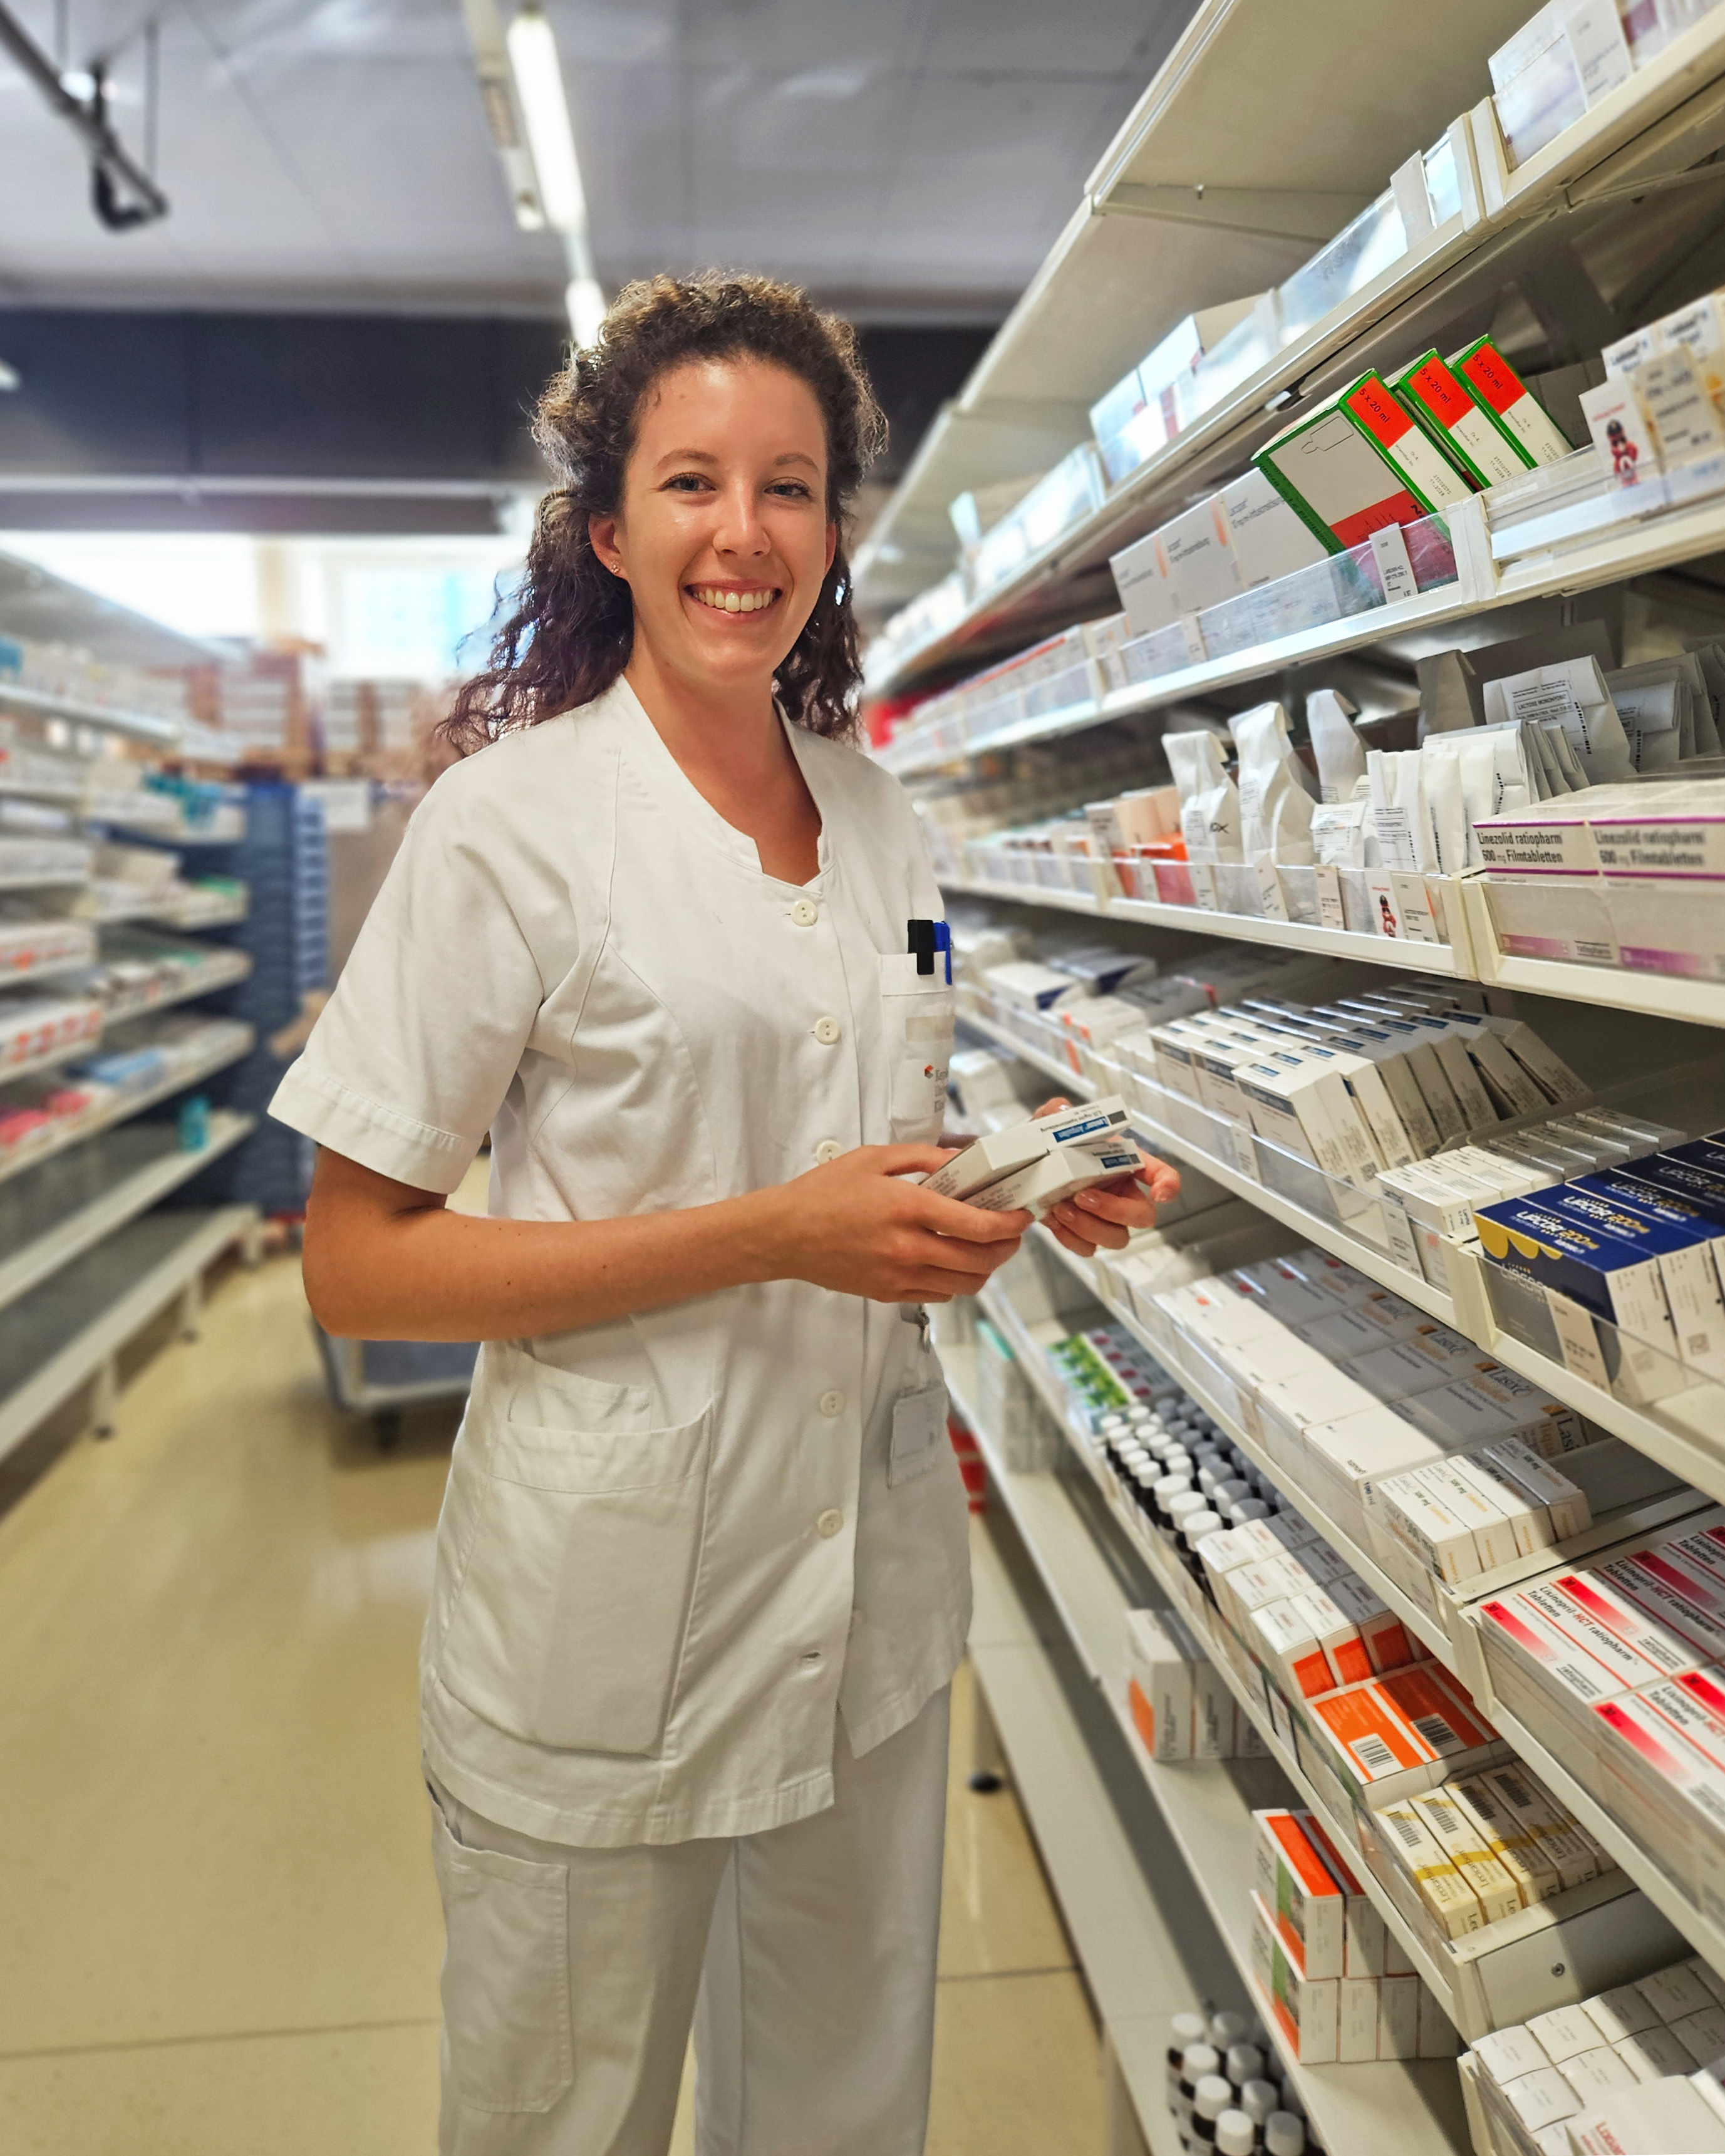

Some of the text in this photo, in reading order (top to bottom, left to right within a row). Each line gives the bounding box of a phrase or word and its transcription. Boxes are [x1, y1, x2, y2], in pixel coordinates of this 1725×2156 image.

[1483, 366, 1494, 379] 20
[1492, 379, 1503, 390] ml
[1431, 381, 1442, 394] 20
[1439, 392, 1451, 404] ml
[1370, 400, 1381, 413] 20
[1379, 412, 1391, 423] ml
[1478, 831, 1563, 847] Linezolid ratiopharm
[1594, 831, 1705, 849] Linezolid ratiopharm
[1482, 850, 1496, 861] 600
[1507, 850, 1563, 864] Filmtabletten
[1599, 851, 1616, 864] 600
[1630, 851, 1705, 866] Filmtabletten
[1678, 1539, 1716, 1565] Tabletten
[1603, 1564, 1639, 1592] Tabletten
[1528, 1590, 1561, 1618] Tabletten
[1539, 1586, 1594, 1627] Lisinopril-HCT
[1589, 1624, 1633, 1661] ratiopharm
